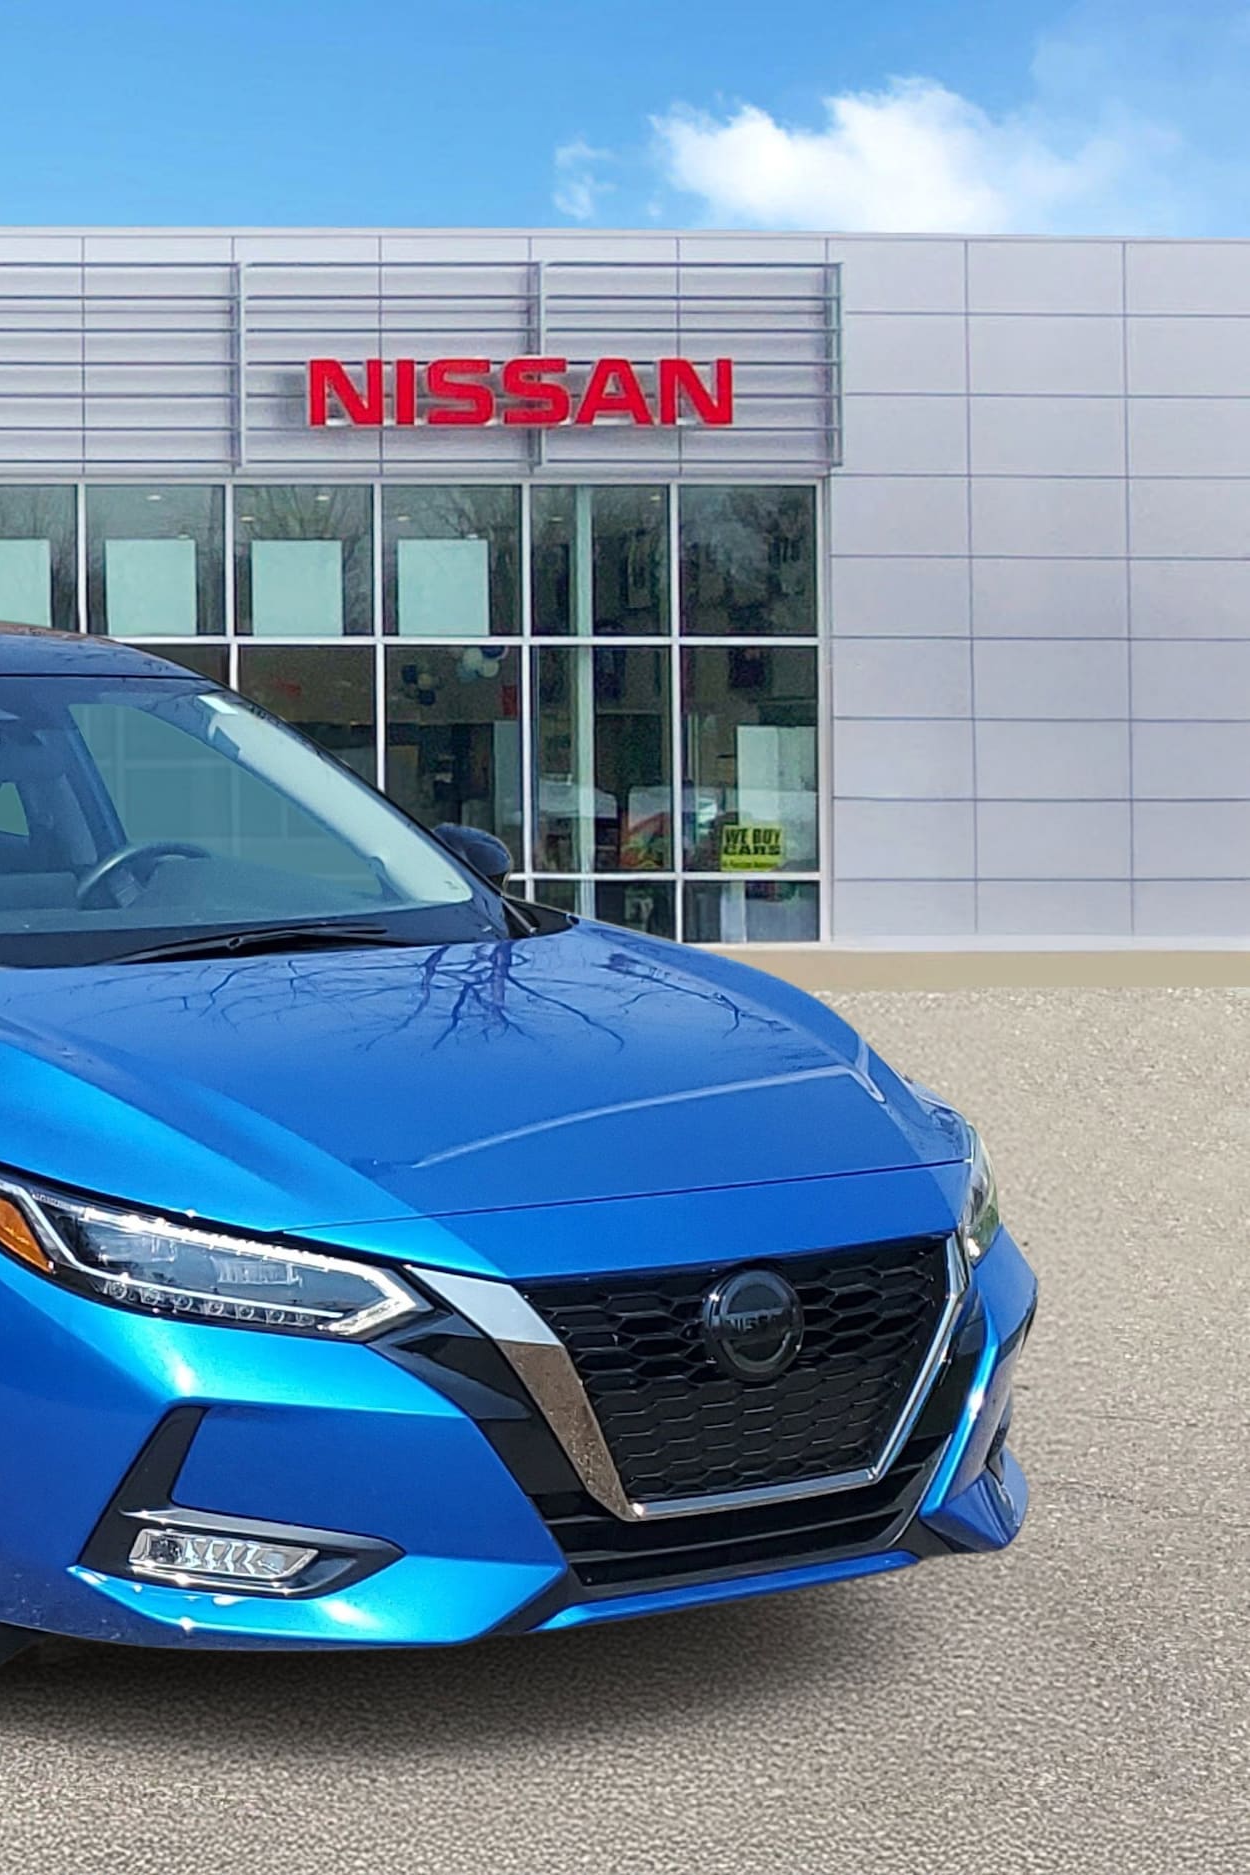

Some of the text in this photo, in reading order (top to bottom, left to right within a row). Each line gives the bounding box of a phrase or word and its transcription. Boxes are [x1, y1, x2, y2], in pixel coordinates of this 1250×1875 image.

[306, 357, 734, 427] NISSAN
[724, 828, 782, 844] WE BUY
[723, 844, 781, 856] CARS
